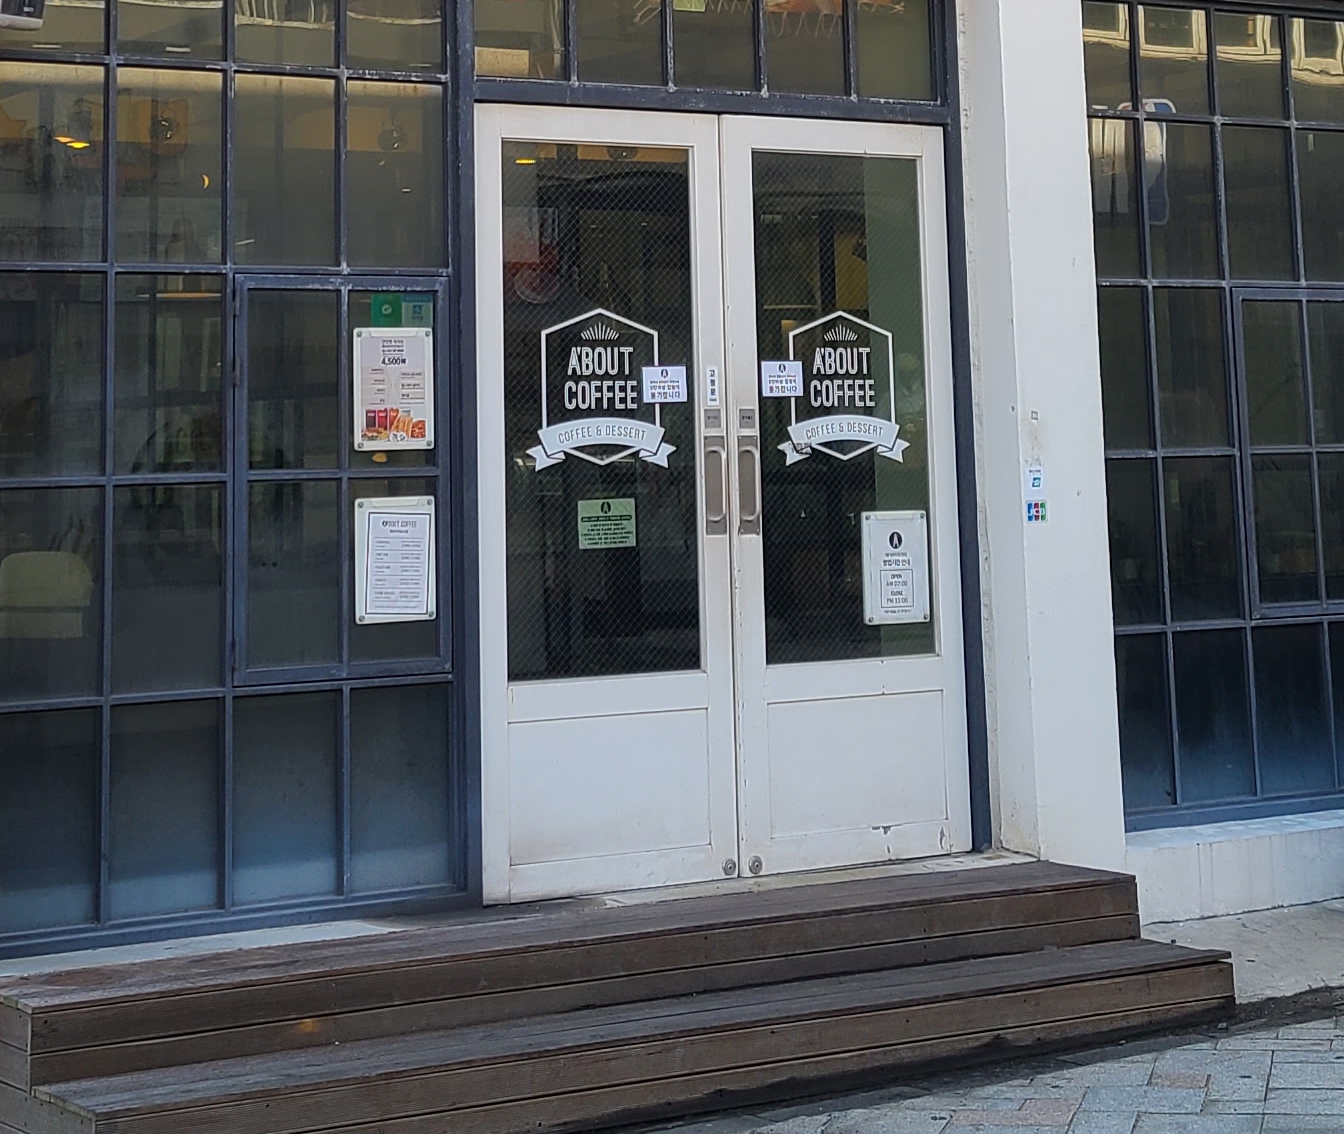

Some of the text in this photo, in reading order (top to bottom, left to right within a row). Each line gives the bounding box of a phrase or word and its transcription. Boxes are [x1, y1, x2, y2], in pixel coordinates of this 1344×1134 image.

[564, 380, 638, 410] COFFEE
[810, 379, 876, 408] COFFEE
[558, 426, 592, 444] COFFEE
[606, 425, 647, 441] DESSERT
[805, 423, 836, 440] COFFEE
[847, 422, 884, 438] DESSERT
